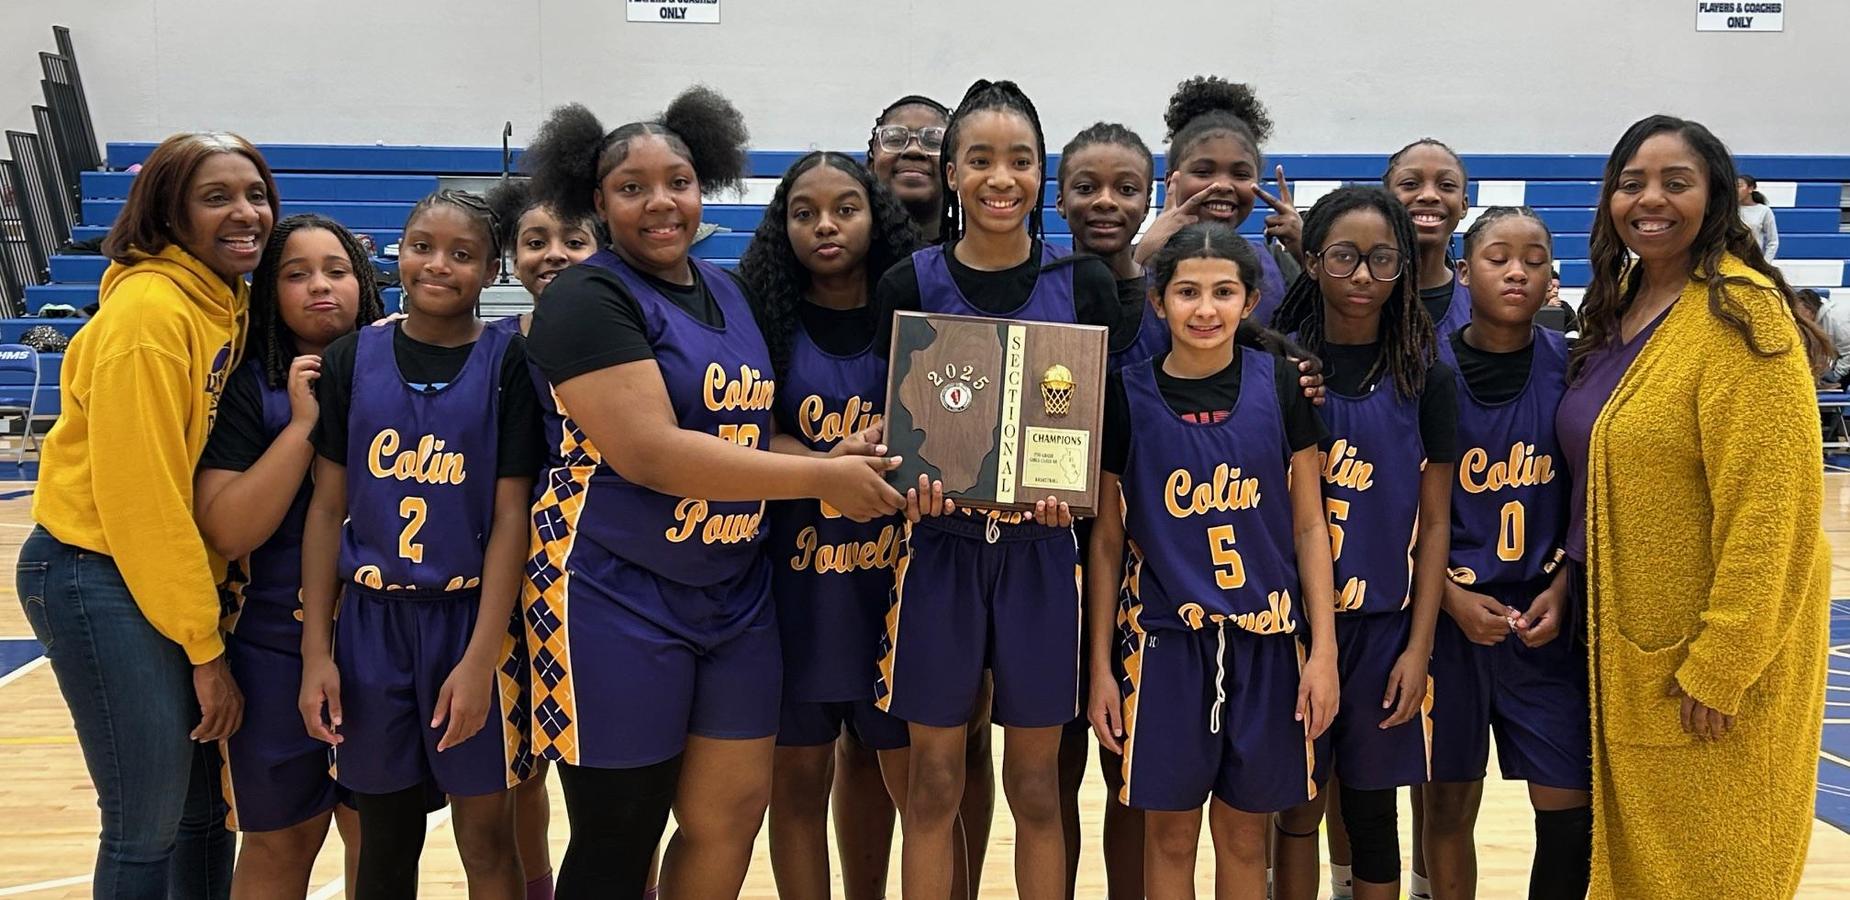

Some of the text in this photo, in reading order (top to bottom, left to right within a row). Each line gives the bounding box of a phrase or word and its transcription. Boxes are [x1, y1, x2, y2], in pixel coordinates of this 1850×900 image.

[660, 7, 687, 19] ONLY
[1699, 3, 1782, 13] PLAYERS & COACHES
[1727, 17, 1753, 28] ONLY
[703, 362, 776, 412] Colin
[927, 363, 990, 390] 2025
[1001, 335, 1021, 493] SECTIONAL
[1032, 433, 1082, 446] CHAMPIONS
[368, 428, 466, 485] Colin
[1459, 441, 1555, 494] Colin
[1164, 463, 1261, 519] Colin
[398, 496, 428, 564] 2
[1497, 500, 1525, 562] 0
[1207, 524, 1247, 590] 5
